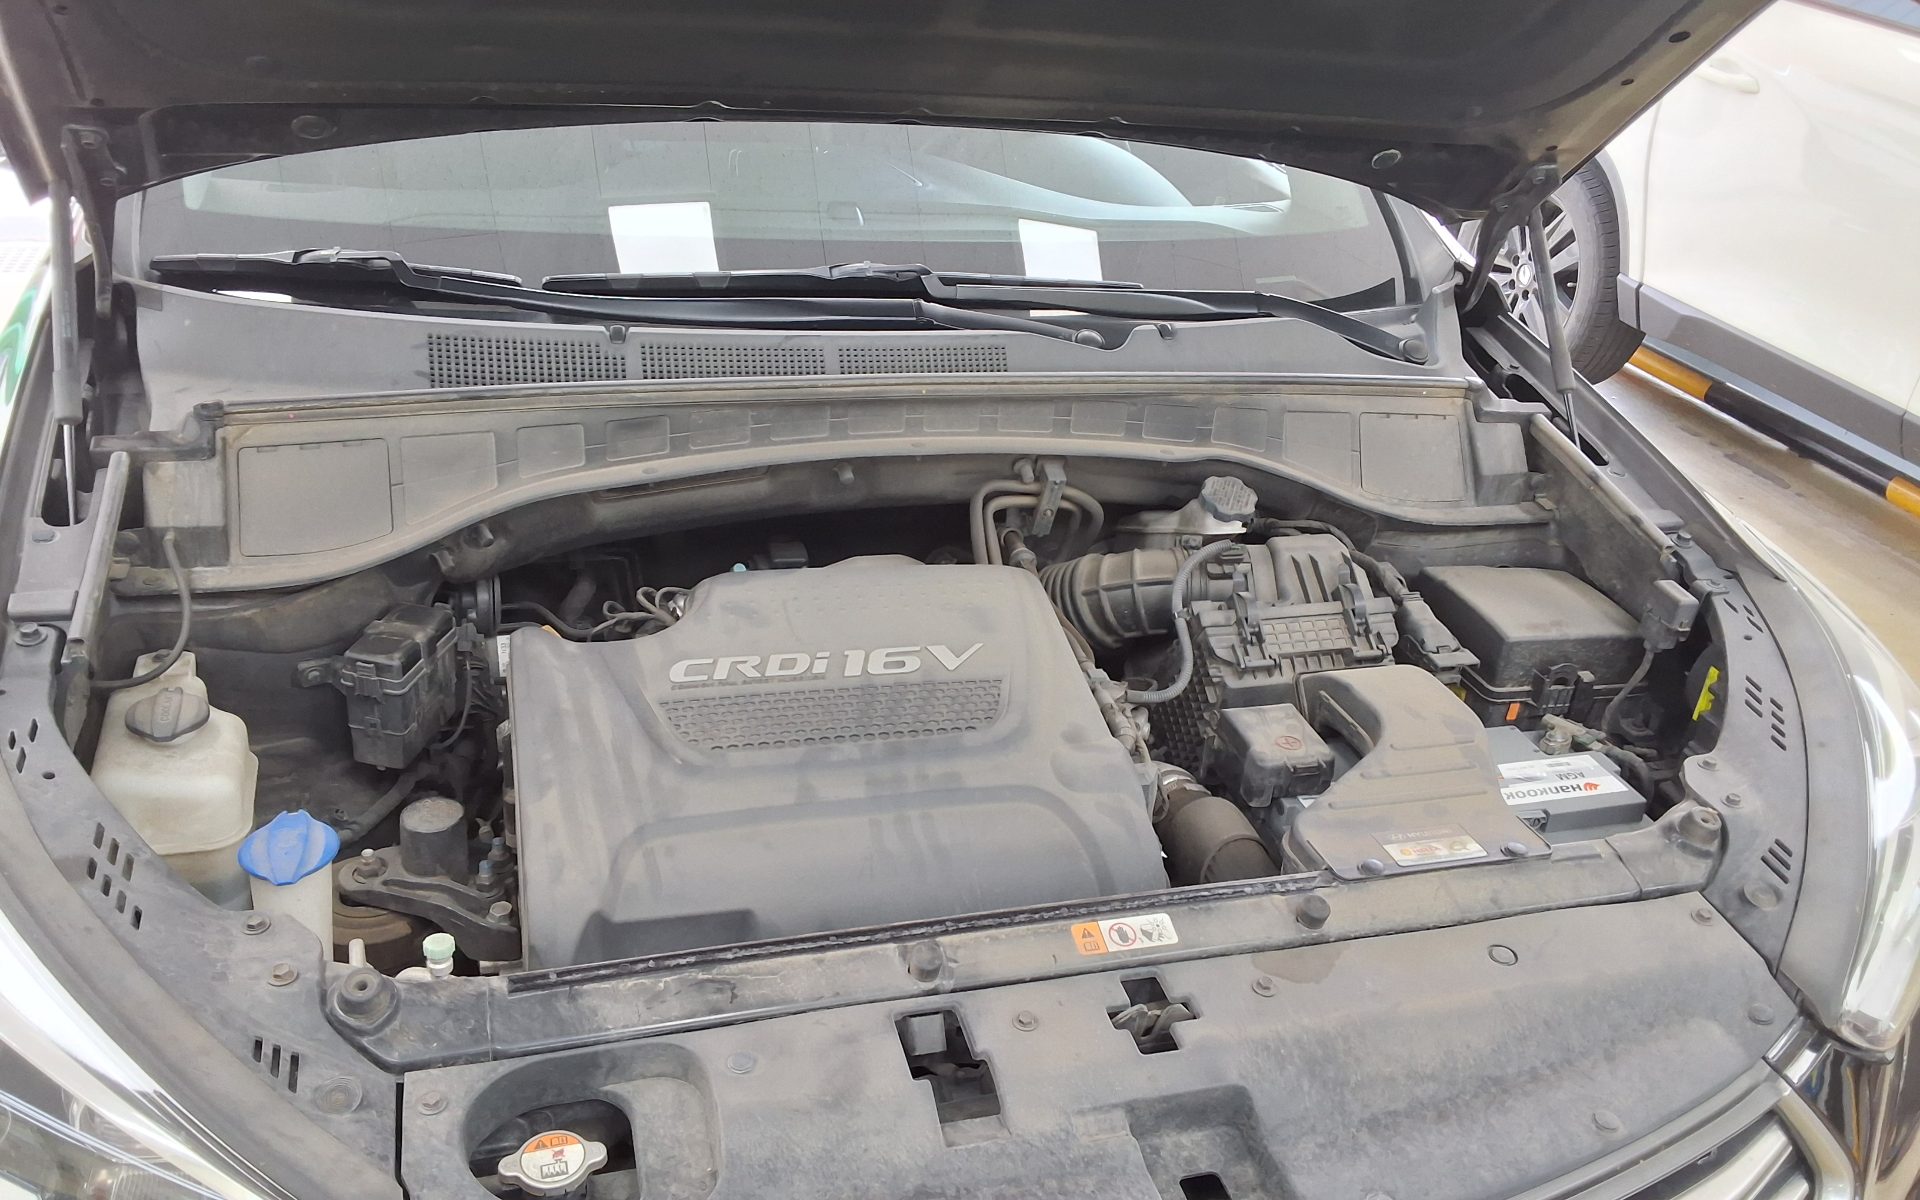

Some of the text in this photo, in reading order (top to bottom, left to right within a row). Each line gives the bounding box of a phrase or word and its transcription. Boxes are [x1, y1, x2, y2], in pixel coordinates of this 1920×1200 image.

[669, 642, 985, 683] CRDi 16V
[1555, 771, 1585, 781] AGM
